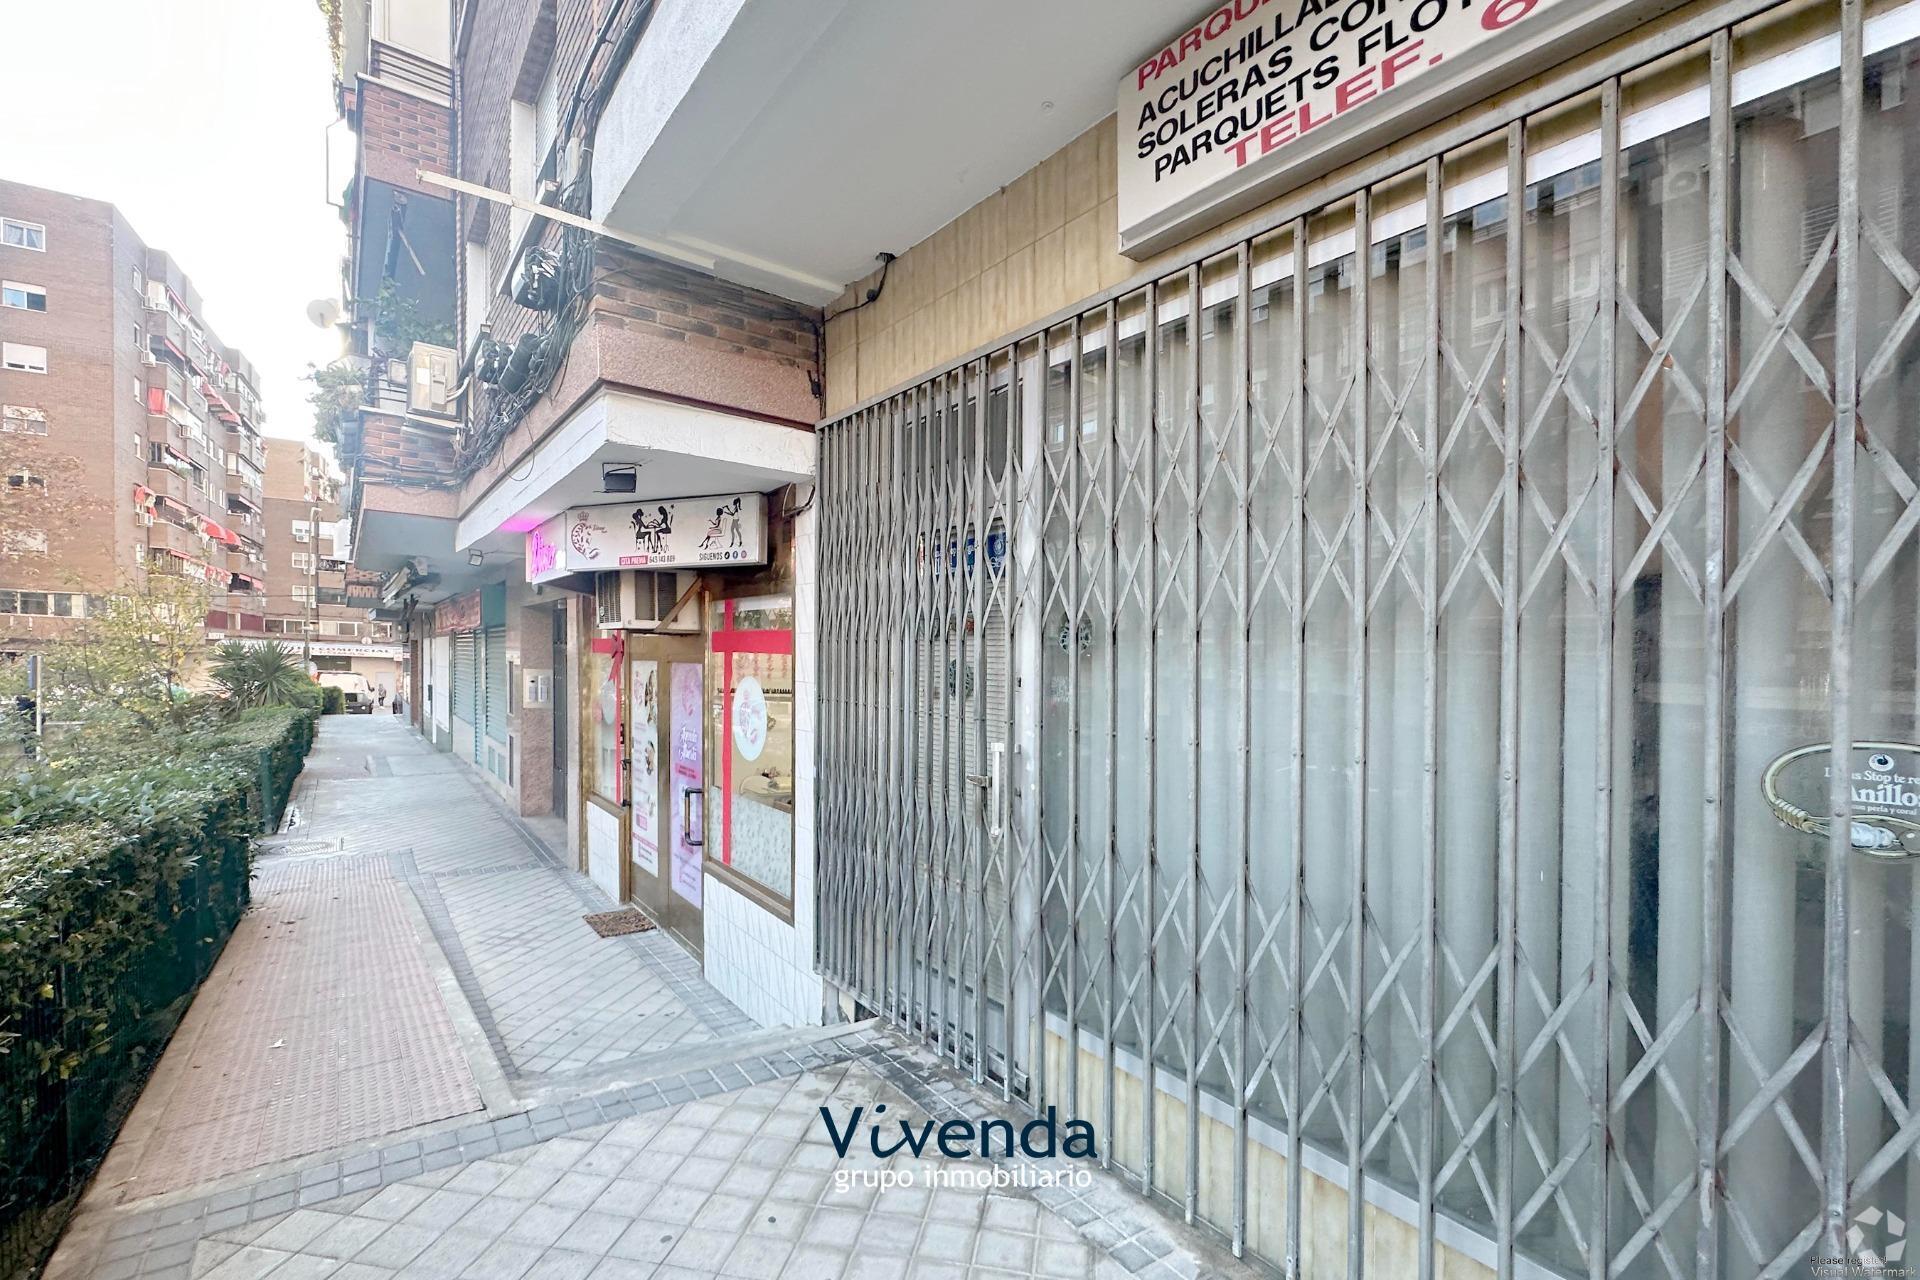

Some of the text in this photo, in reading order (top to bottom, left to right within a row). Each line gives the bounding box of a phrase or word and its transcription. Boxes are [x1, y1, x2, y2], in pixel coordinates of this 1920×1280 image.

[1137, 0, 1341, 131] ACUCHILLA
[1137, 45, 1293, 159] SOLERAS
[1154, 0, 1471, 183] PARQUETS FLO
[1223, 38, 1443, 169] TELEF.
[1864, 770, 1891, 784] Stop
[1894, 773, 1905, 783] te
